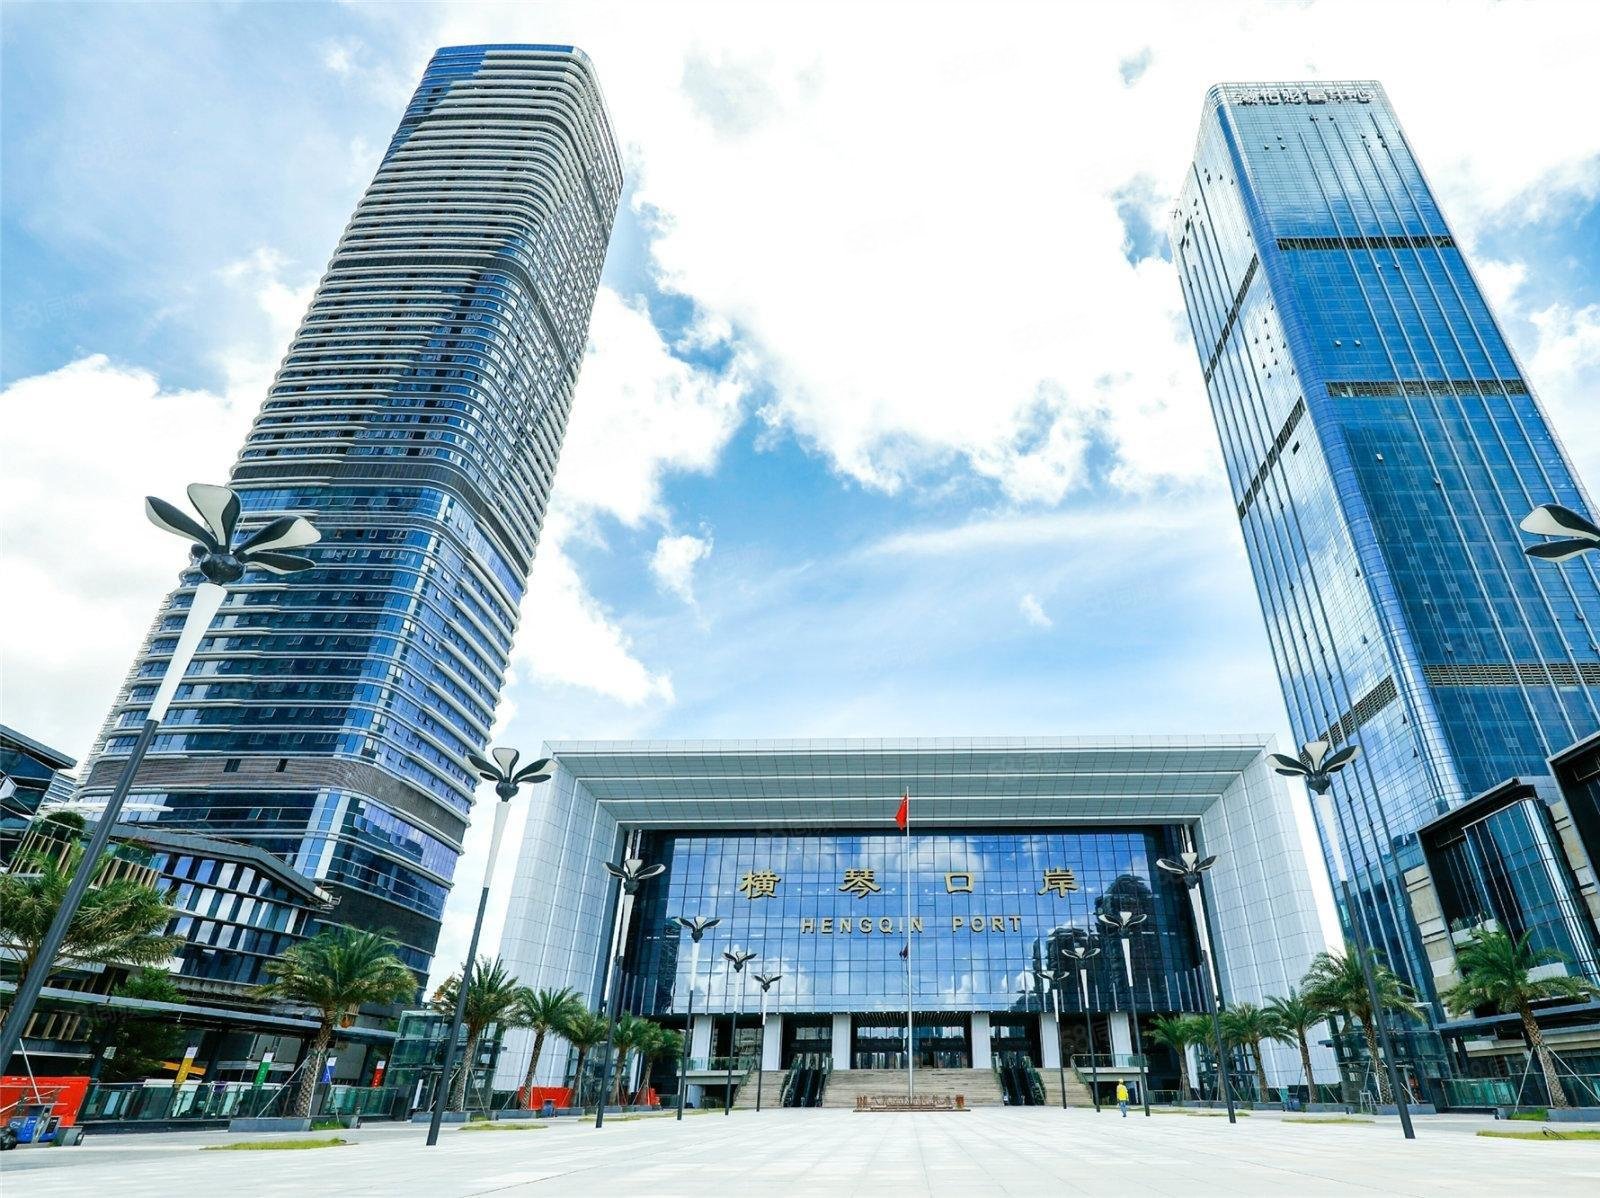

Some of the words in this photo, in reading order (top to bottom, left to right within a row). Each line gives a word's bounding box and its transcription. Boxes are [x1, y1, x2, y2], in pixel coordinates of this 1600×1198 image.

[739, 867, 1080, 899] 横琴口岸
[801, 917, 924, 935] HENGQIN
[952, 915, 1022, 934] PORT
